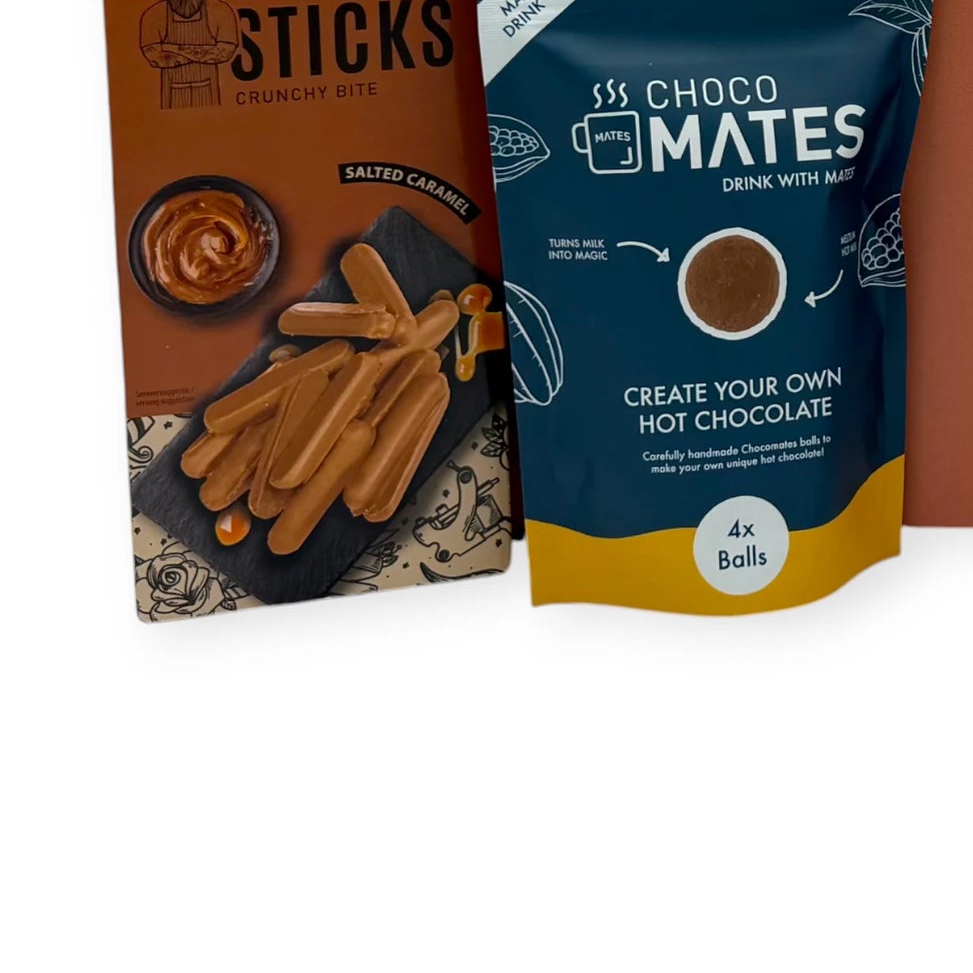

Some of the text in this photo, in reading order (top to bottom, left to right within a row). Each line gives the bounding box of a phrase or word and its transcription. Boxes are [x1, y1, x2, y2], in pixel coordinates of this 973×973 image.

[235, 82, 378, 105] CRUNCHY BITE
[646, 75, 778, 110] CHOCO
[594, 130, 631, 144] MATES
[649, 104, 866, 173] MATES
[345, 166, 471, 216] SALTED CARAMEL
[722, 174, 774, 193] DRINK
[777, 171, 819, 188] WITH
[548, 238, 605, 248] TURNS MILK
[548, 250, 608, 261] INTO MAGIC
[623, 367, 843, 408] CREATE YOUR OWN
[639, 396, 833, 435] HOT CHOCOLATE
[642, 435, 831, 462] Carefully handmade Chocomates balls to
[651, 447, 825, 475] make your own unique hot chocolate!
[727, 518, 755, 538] 4x
[718, 544, 767, 570] Balls
